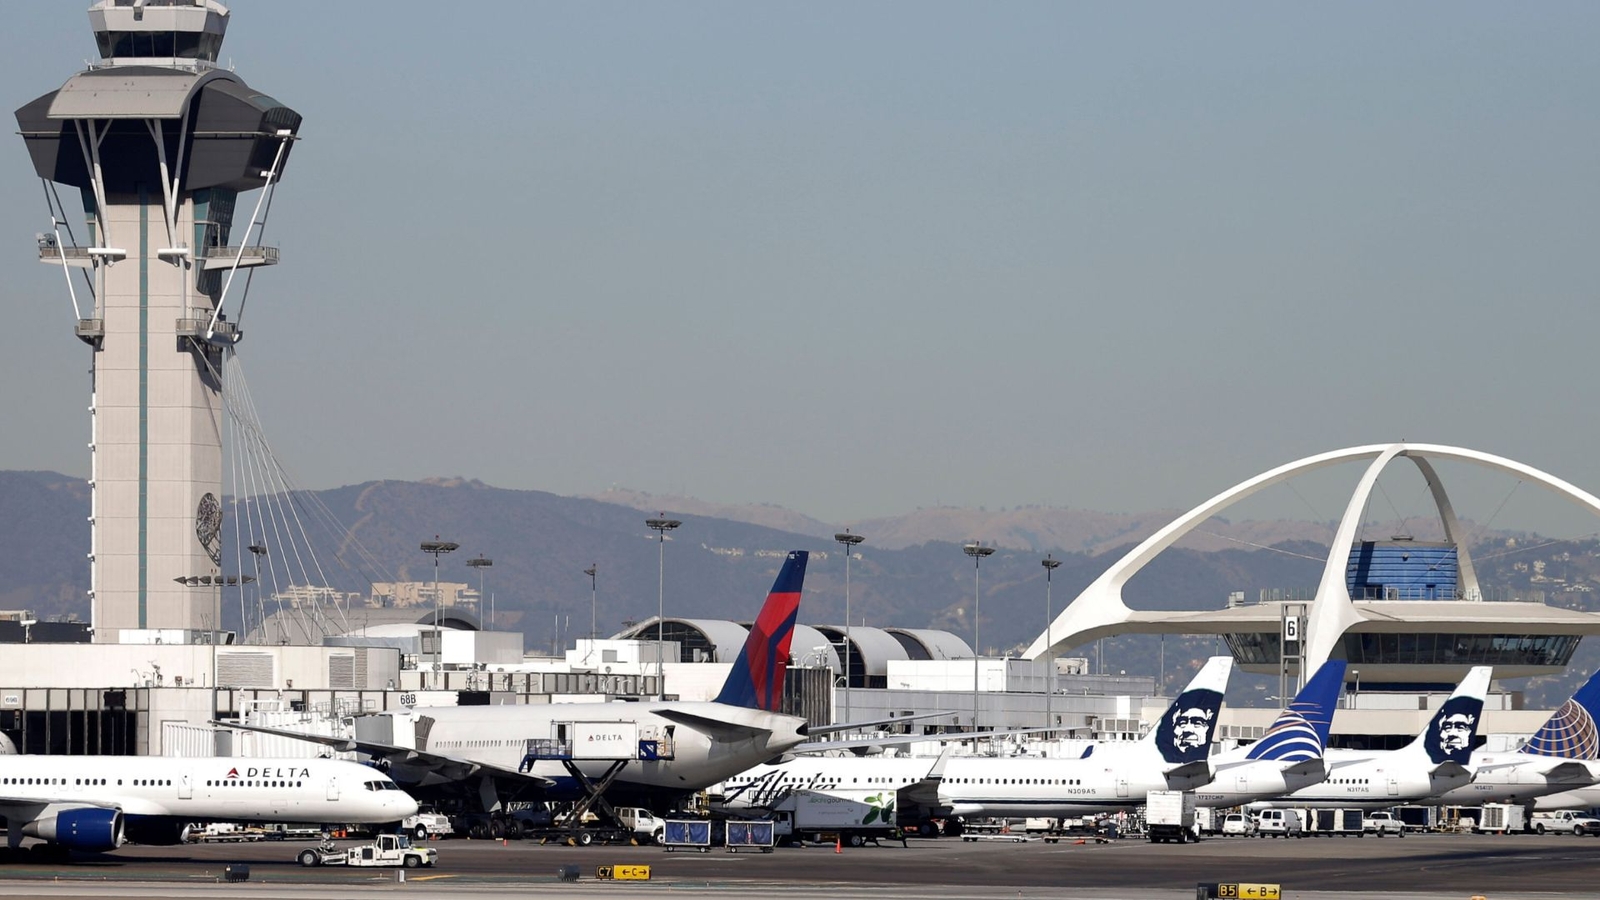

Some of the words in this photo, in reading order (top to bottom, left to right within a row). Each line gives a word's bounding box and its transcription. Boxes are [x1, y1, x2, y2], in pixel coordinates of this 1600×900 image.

[1287, 620, 1295, 636] 6
[400, 694, 416, 704] 68B
[247, 767, 310, 778] DELTA
[598, 867, 611, 876] C7
[631, 867, 638, 876] C
[1220, 885, 1236, 896] B5
[1260, 887, 1267, 896] B
